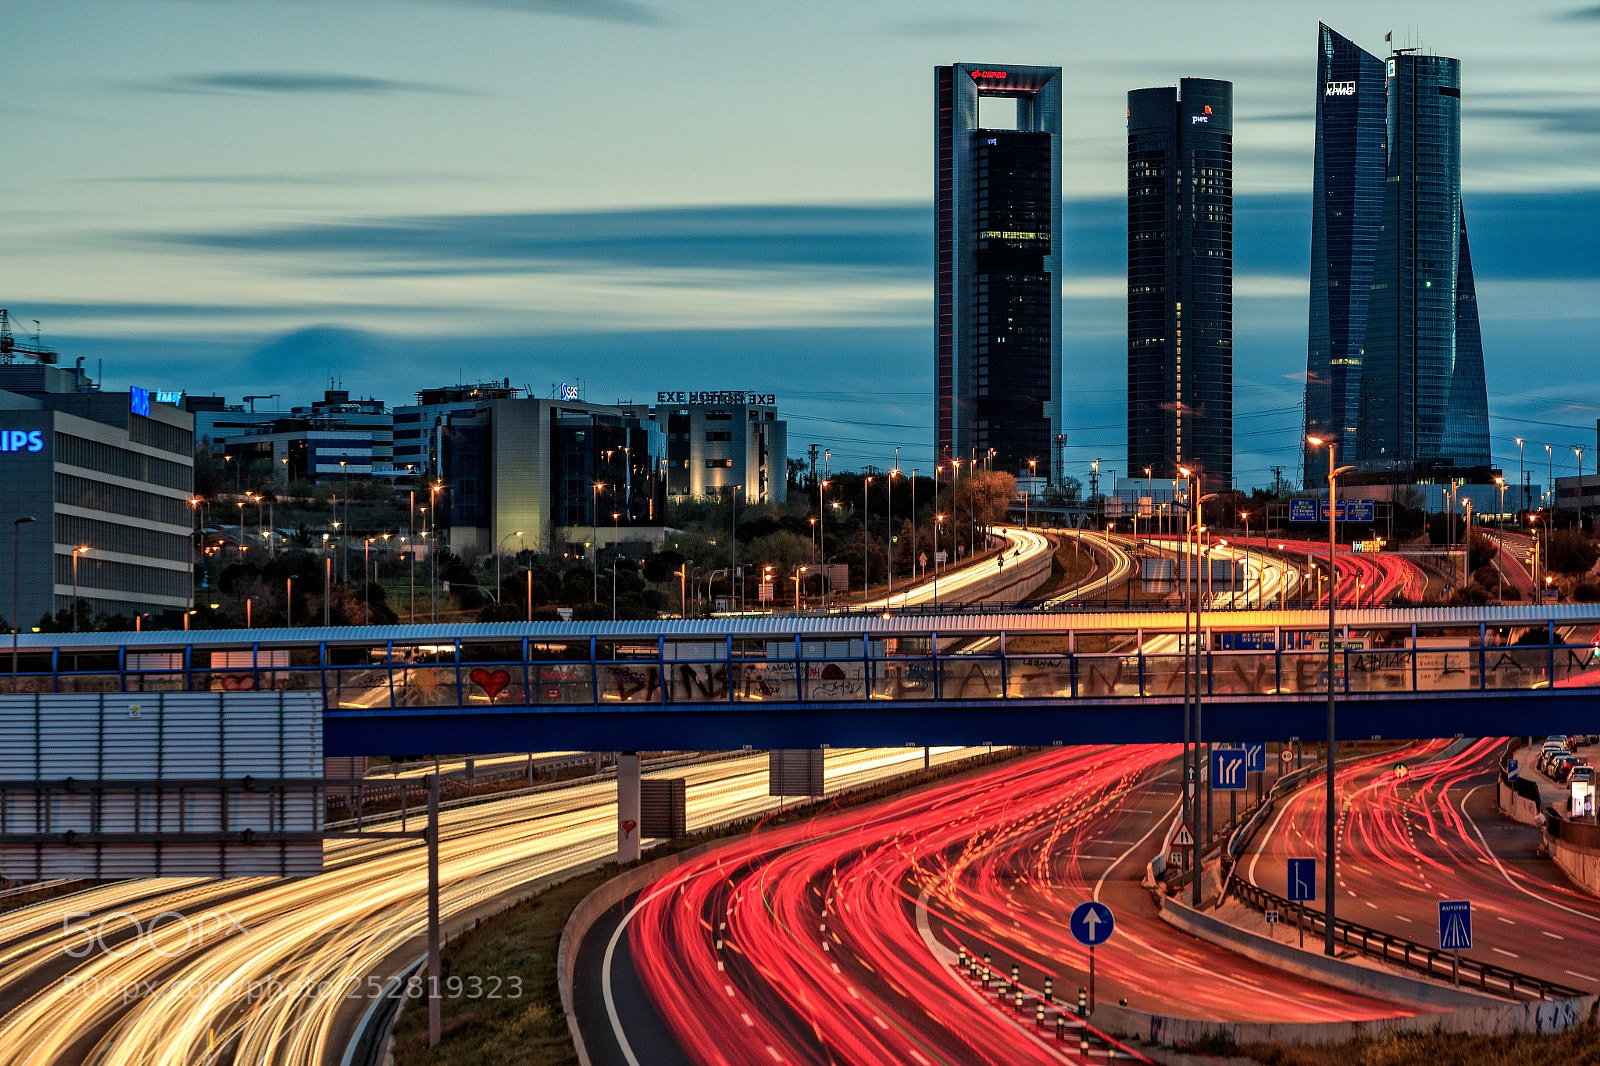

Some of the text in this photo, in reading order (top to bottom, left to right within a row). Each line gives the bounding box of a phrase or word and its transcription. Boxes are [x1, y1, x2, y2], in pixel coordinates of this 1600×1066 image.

[1326, 87, 1354, 96] KPMG
[1192, 116, 1208, 125] pwc
[657, 391, 686, 403] EXE
[0, 430, 44, 453] IPS
